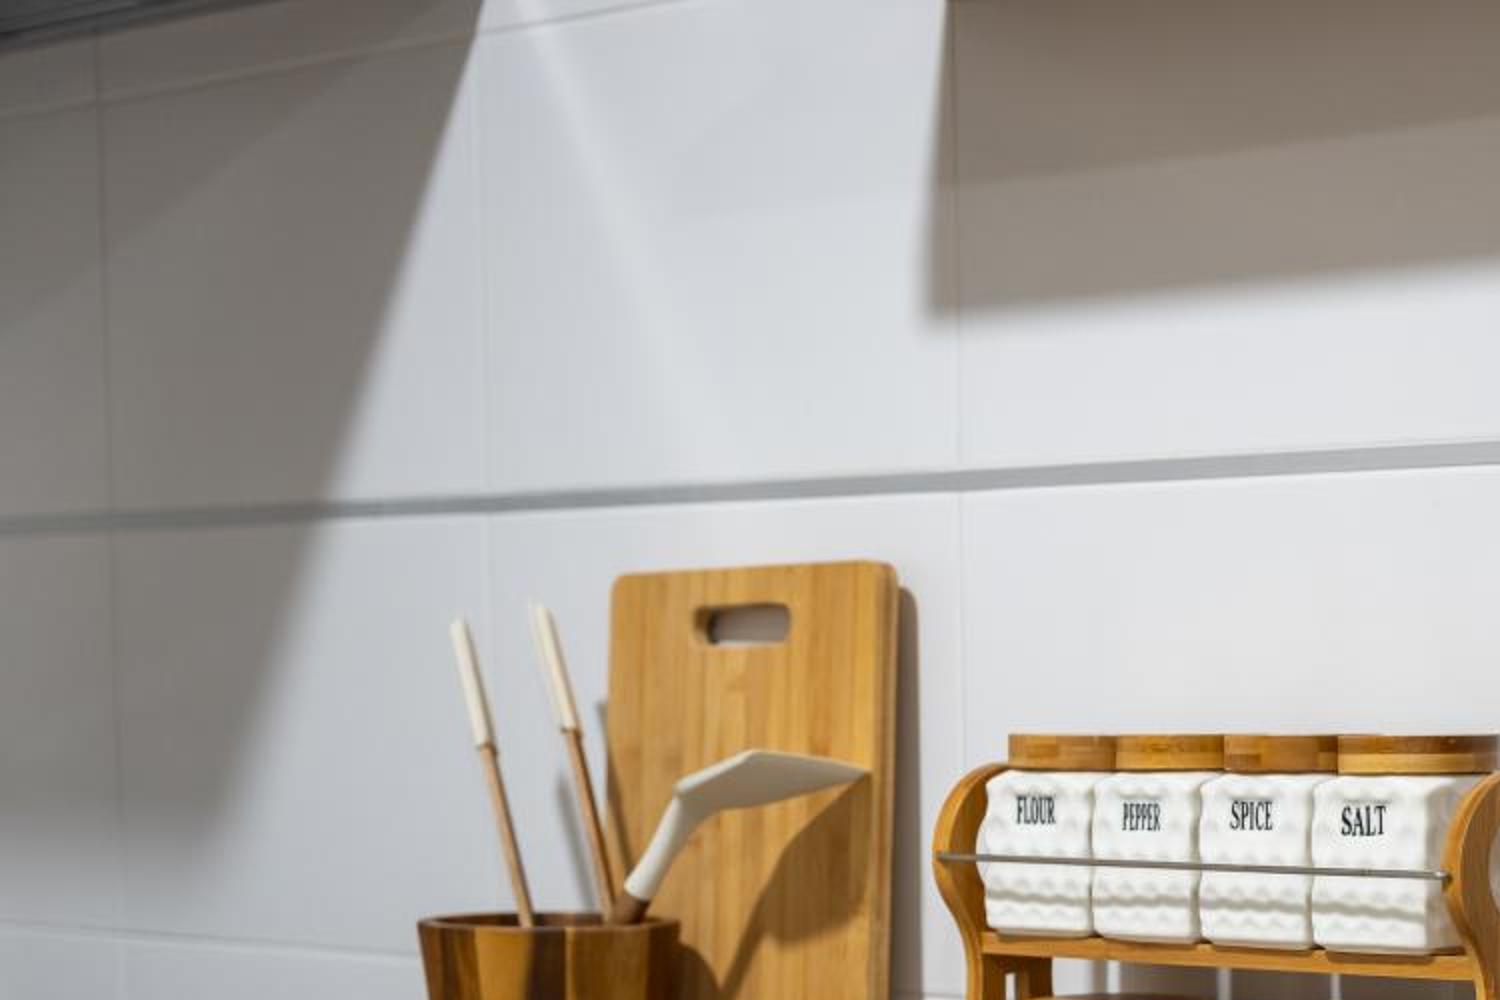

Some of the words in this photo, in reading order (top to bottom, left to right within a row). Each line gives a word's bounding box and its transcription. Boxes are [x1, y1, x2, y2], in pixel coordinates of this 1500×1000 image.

[1016, 796, 1056, 825] FLOUR
[1122, 803, 1161, 832] PEPPER
[1230, 801, 1274, 831] SPICE
[1340, 805, 1387, 837] SALT
